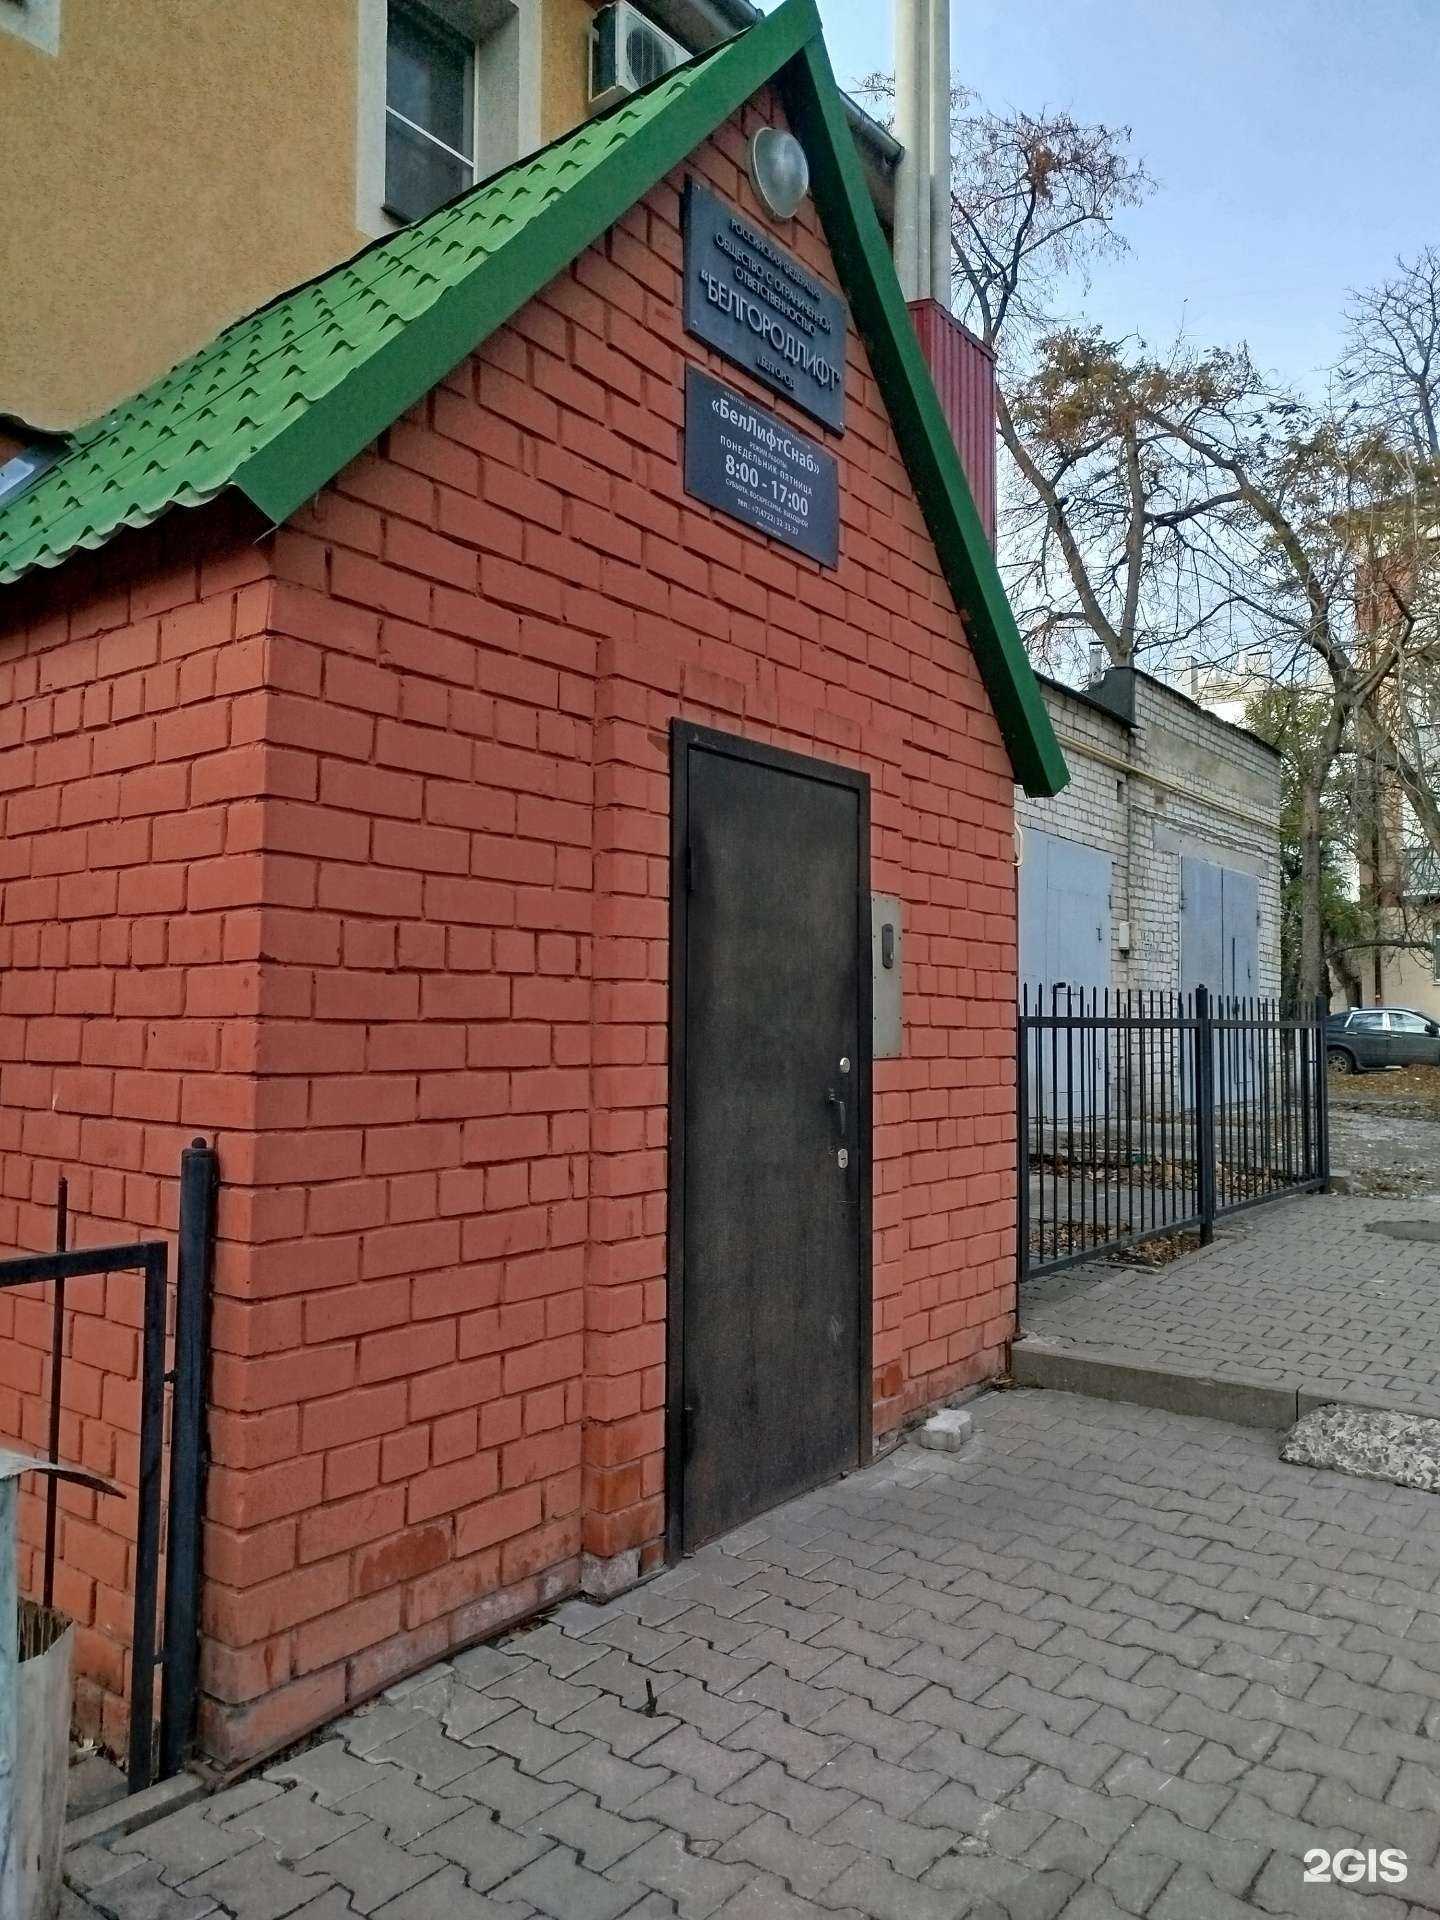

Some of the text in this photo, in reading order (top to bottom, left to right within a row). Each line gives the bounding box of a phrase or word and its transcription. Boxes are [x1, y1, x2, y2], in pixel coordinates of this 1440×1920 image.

[715, 232, 763, 278] ОБЩЕСТВО
[774, 278, 832, 335] ОГРАНИЧЕННОЙ
[735, 265, 816, 338] ОТВЕТСТВЕННОСТЬЮ
[711, 397, 821, 476] «БелЛифтСнаб»
[720, 434, 813, 497] ПОНЕДЕЛЬНИК ПЯТНИЦА
[725, 454, 759, 488] 8:00
[771, 480, 809, 516] 17:00
